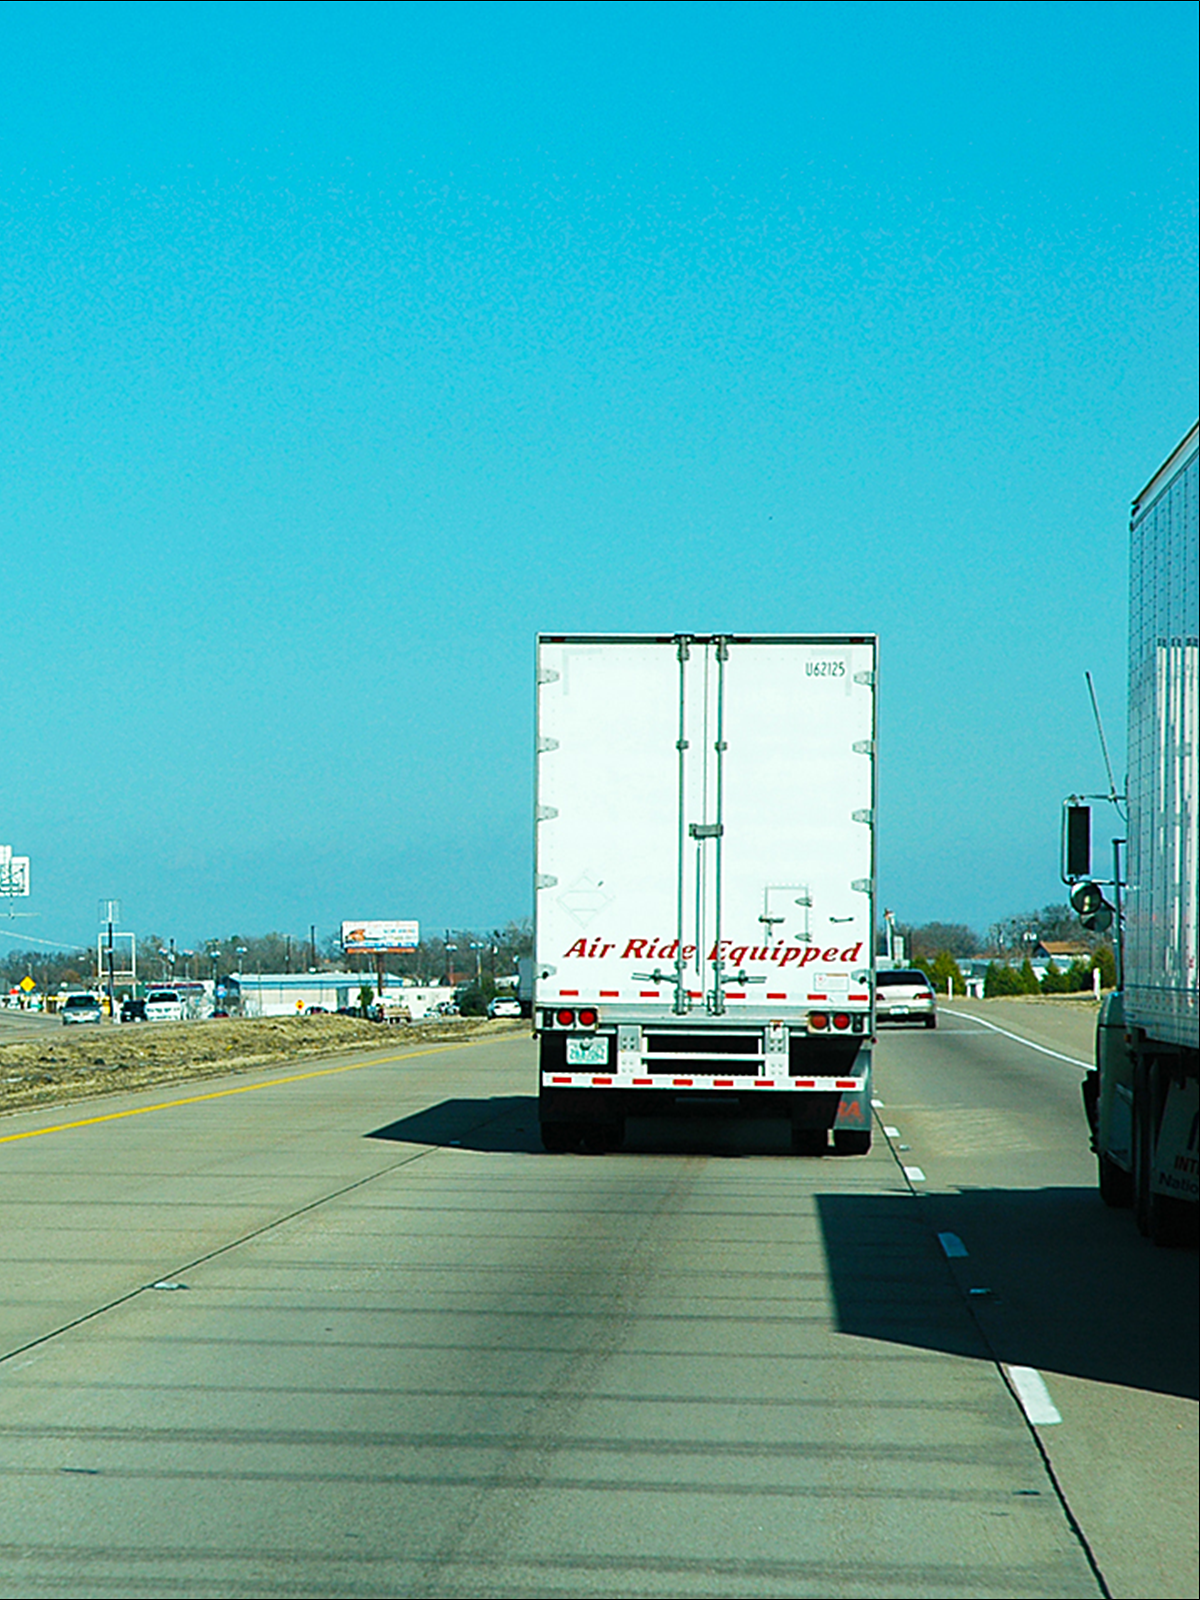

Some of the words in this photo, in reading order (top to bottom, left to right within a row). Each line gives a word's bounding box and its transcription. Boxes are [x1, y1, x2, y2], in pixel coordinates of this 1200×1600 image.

[805, 661, 846, 677] U62125
[563, 937, 616, 959] Air
[620, 937, 697, 960] Ride
[706, 939, 864, 968] Equipped
[1174, 1155, 1198, 1176] INT
